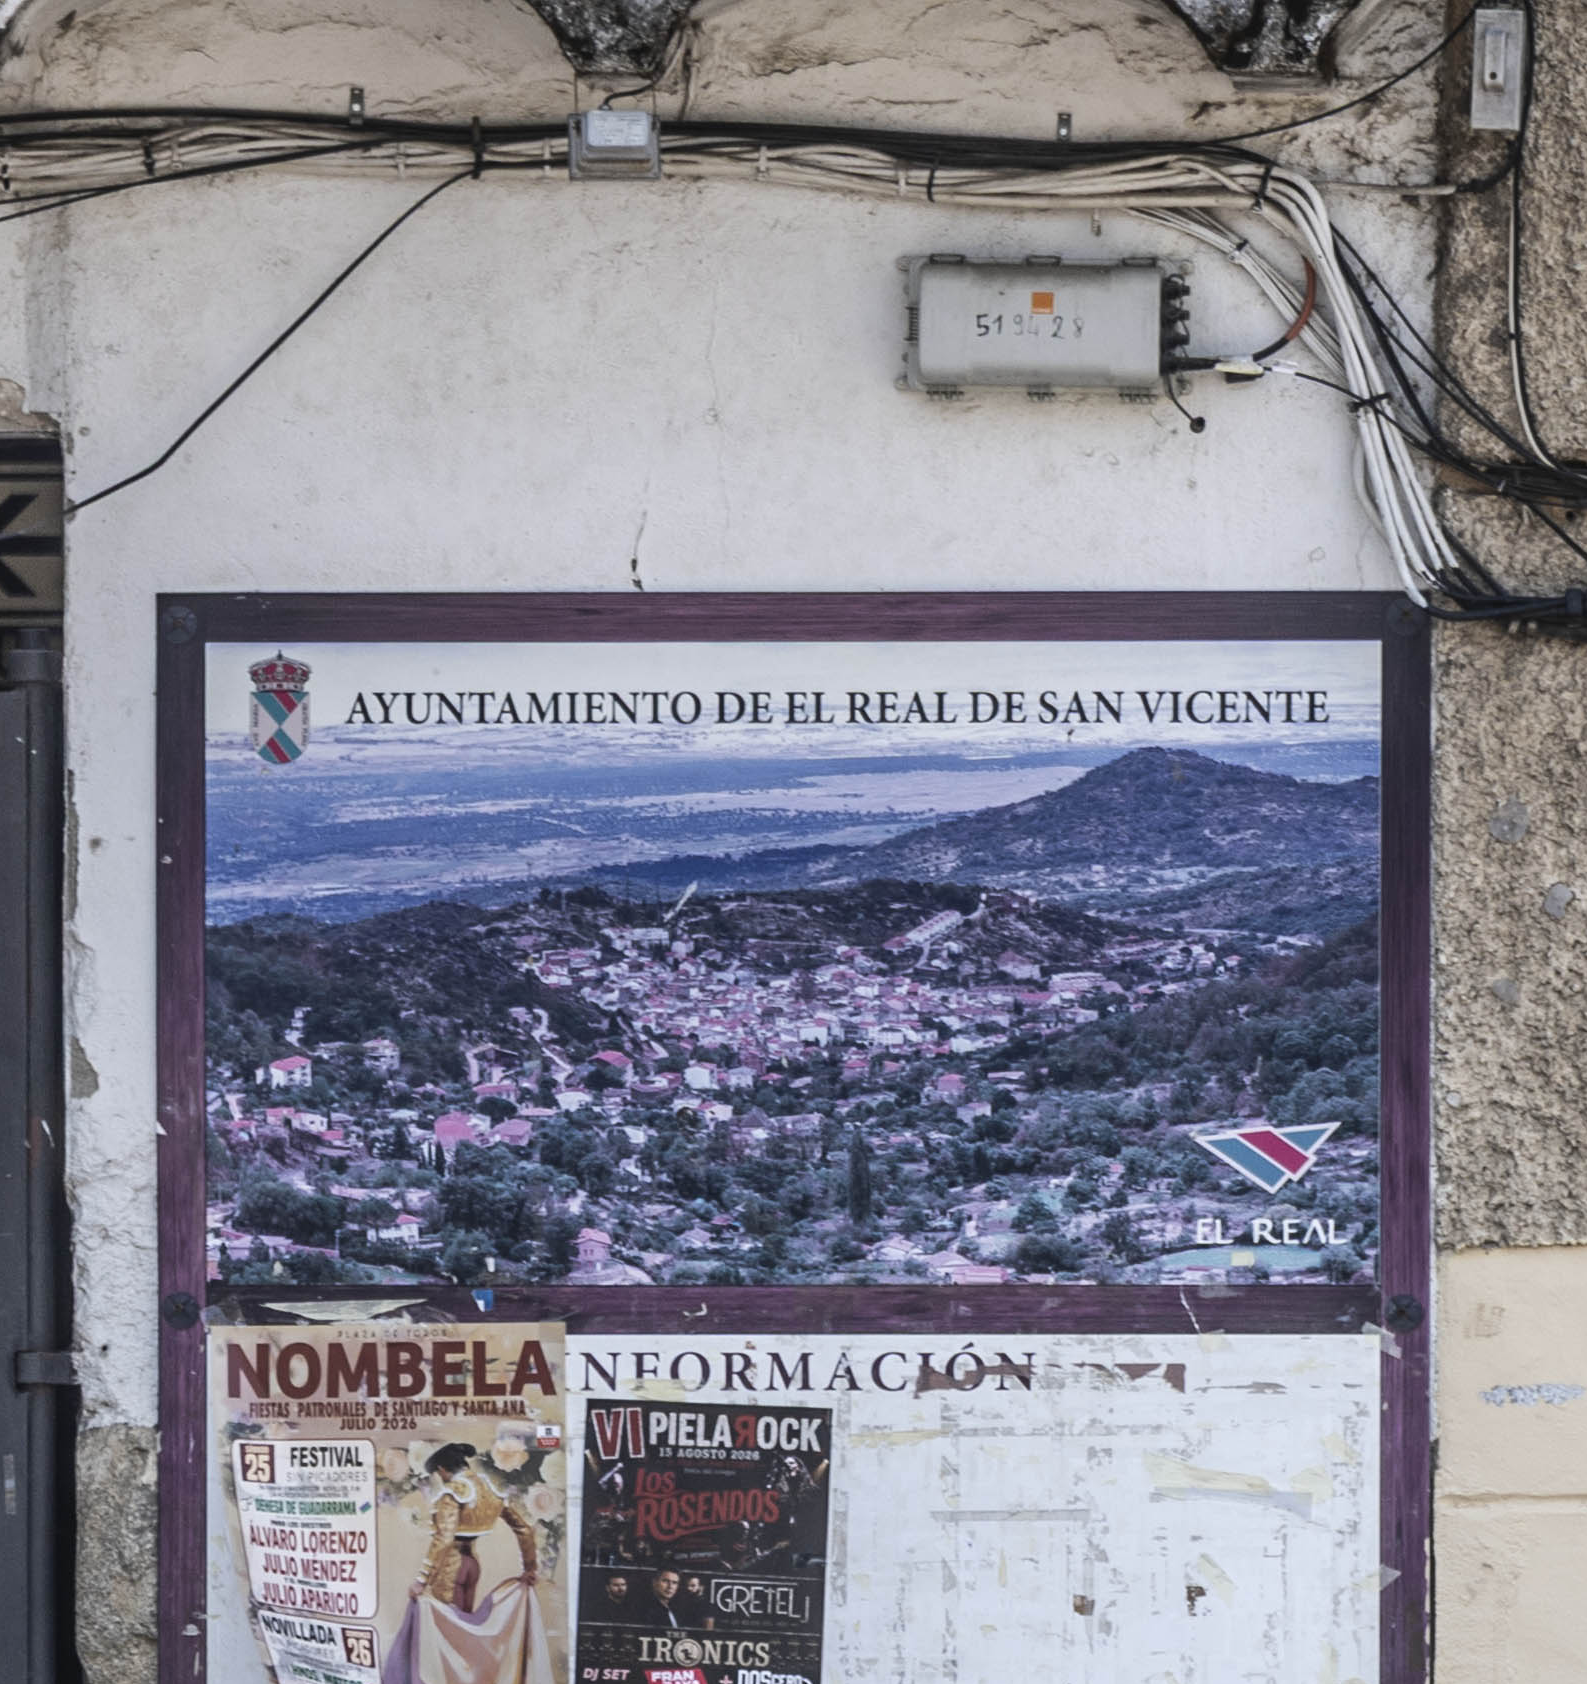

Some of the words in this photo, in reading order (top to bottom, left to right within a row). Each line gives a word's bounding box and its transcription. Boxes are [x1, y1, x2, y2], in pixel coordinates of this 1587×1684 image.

[345, 691, 702, 725] AYUNTAMIENTO
[714, 691, 773, 725] DE
[784, 691, 834, 725] EL
[845, 691, 957, 725] REAL
[969, 691, 1027, 725] DE
[1038, 690, 1124, 725] SAN
[1134, 690, 1331, 725] VICENTE
[1196, 1218, 1235, 1244] EL
[1251, 1218, 1348, 1244] REAL
[226, 1339, 557, 1399] NOMBELA
[565, 1342, 1036, 1392] NFORMACIÓN
[249, 1402, 290, 1418] FIESTAS
[297, 1401, 367, 1418] PATRONALES
[374, 1401, 388, 1417] DE
[392, 1401, 448, 1417] SANTIAGO
[450, 1401, 459, 1416] Y
[463, 1400, 499, 1416] SANTA
[501, 1400, 526, 1416] ANA
[340, 1418, 376, 1431] JULIO
[381, 1418, 417, 1431] 2026
[591, 1407, 645, 1460] VI
[245, 1453, 270, 1482] 25
[290, 1446, 363, 1467] FESTIVAL
[677, 1448, 727, 1460] AGOSTO
[637, 1489, 780, 1542] ROSENDOS
[301, 1530, 367, 1554] LORENZO
[262, 1553, 298, 1577] JULIO
[262, 1582, 297, 1606] JULIO
[301, 1587, 358, 1615] APARICIO
[262, 1615, 337, 1646] NOVILLADA
[347, 1637, 372, 1666] 26
[583, 1668, 599, 1681] DJ
[602, 1668, 630, 1681] SET
